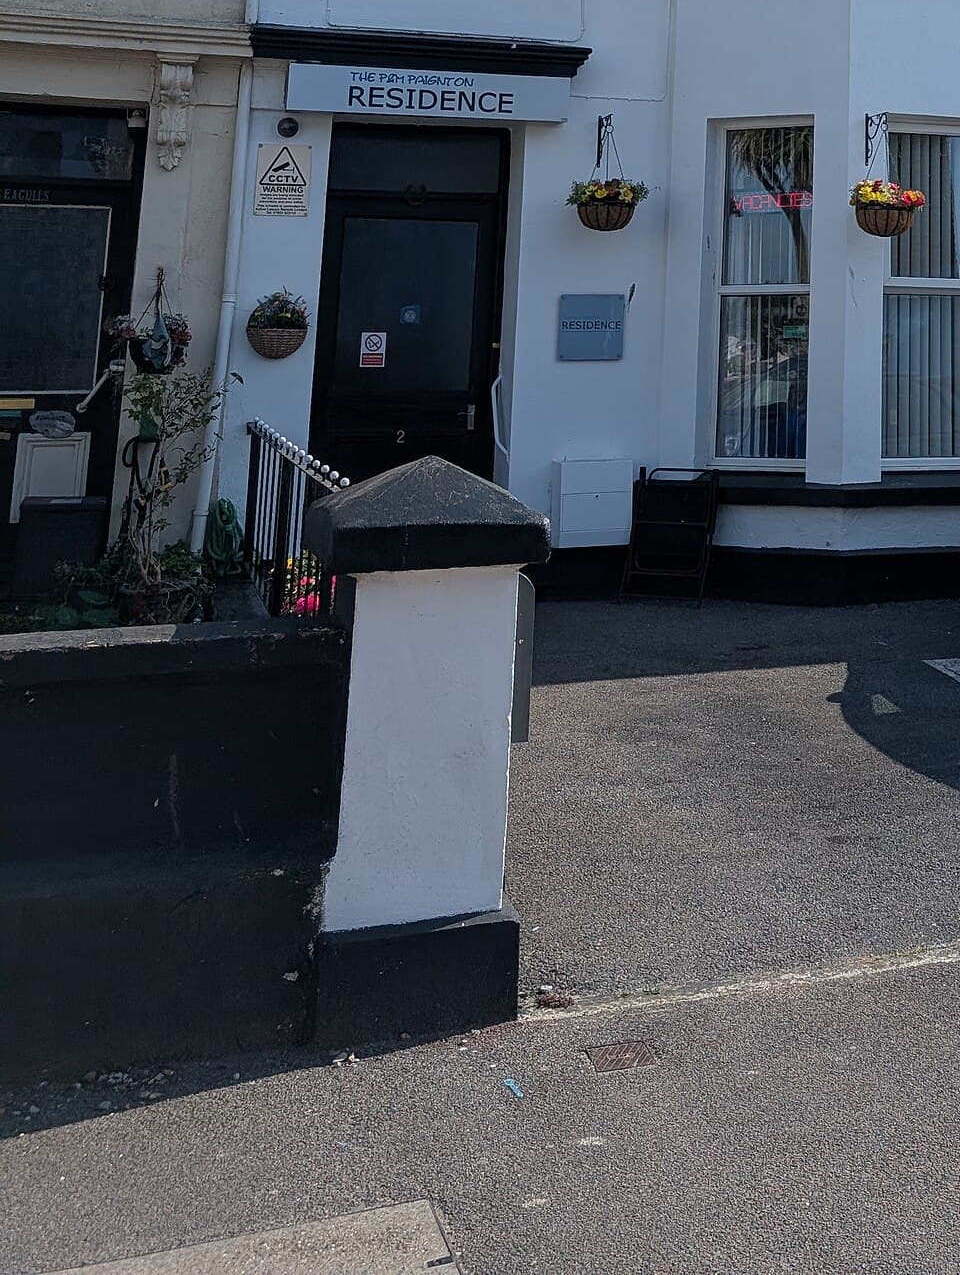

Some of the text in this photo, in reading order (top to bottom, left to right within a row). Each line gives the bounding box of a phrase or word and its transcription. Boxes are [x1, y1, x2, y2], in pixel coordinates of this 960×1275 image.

[350, 71, 475, 87] THE P&M PAIGNTON
[348, 86, 514, 114] RESIDENCE
[268, 174, 299, 183] CCTV
[0, 188, 50, 202] EAGULLS
[262, 186, 304, 194] WARNING
[561, 320, 621, 330] RESIDENCE
[396, 429, 405, 444] 2
